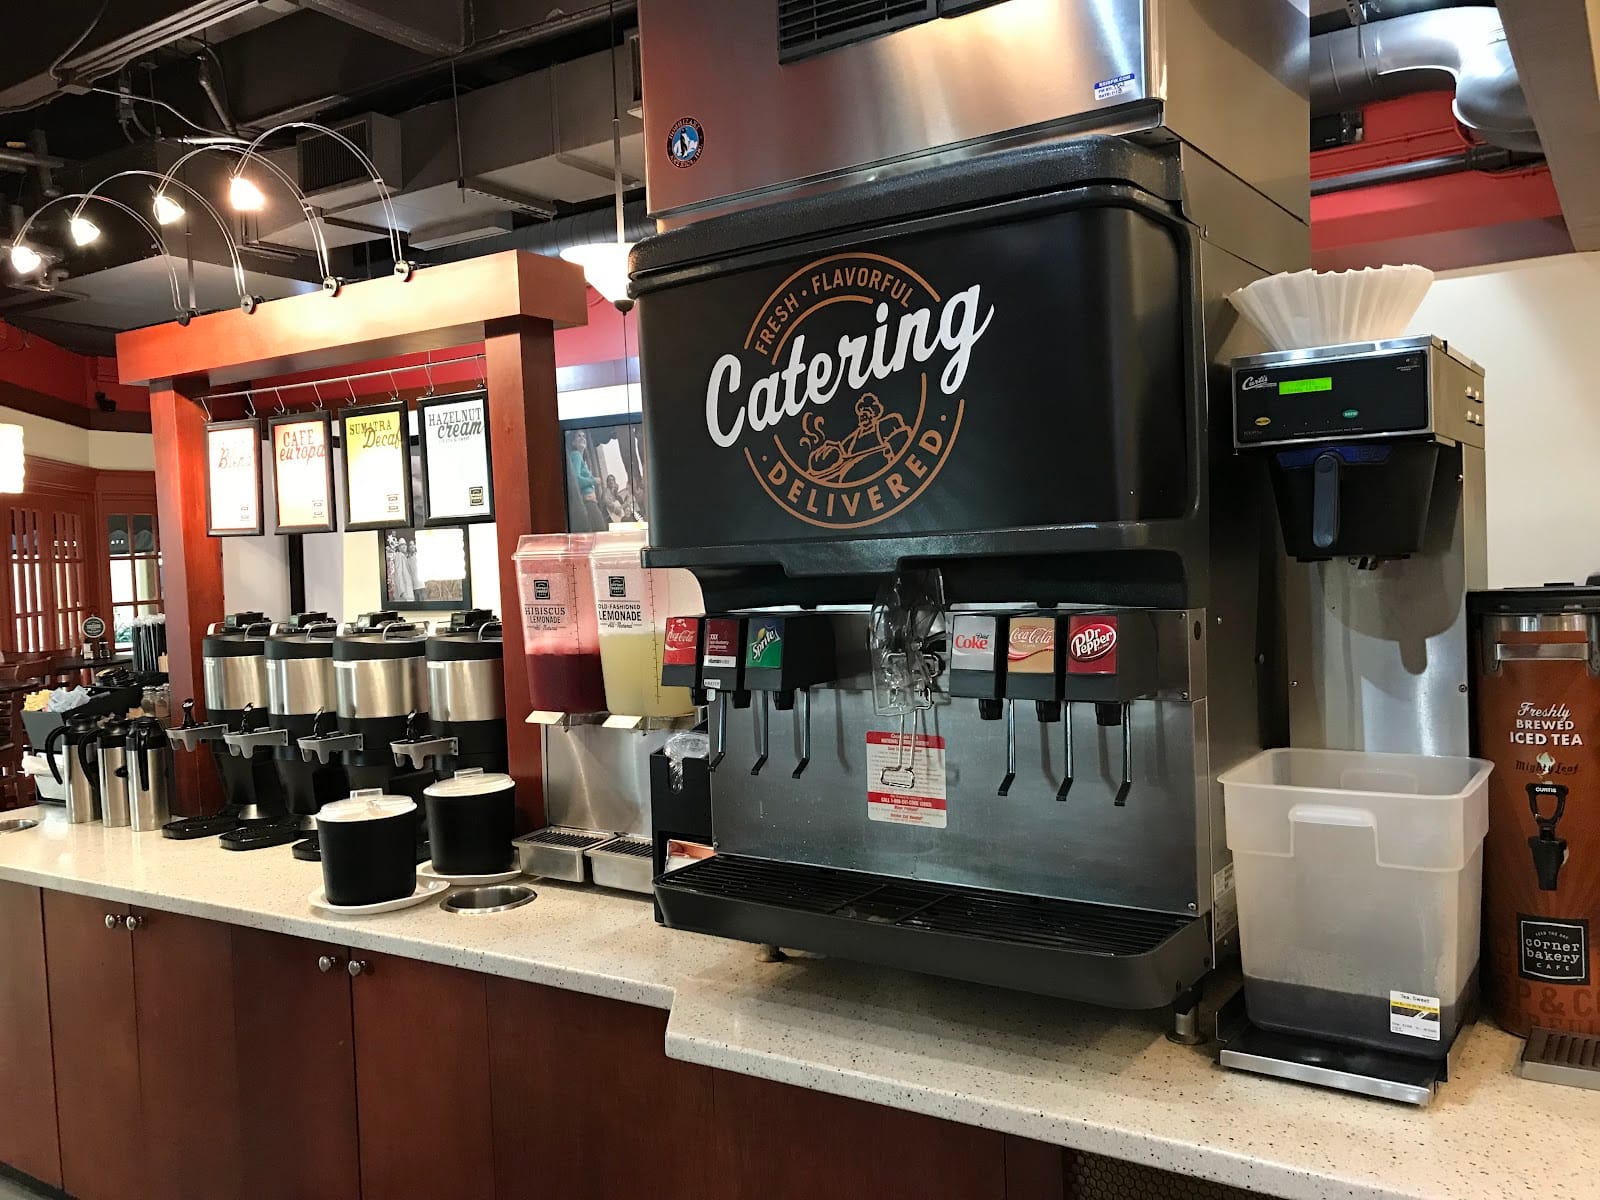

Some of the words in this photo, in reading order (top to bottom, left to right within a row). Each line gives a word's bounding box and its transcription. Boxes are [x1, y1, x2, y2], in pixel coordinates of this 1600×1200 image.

[754, 292, 801, 355] FRESH
[811, 266, 914, 308] FLAVORFUL
[705, 283, 995, 448] Catering
[1242, 375, 1271, 391] Curtis
[428, 407, 482, 426] HAZELNUT
[349, 419, 392, 436] SUMATRA
[437, 420, 483, 439] cream
[282, 428, 314, 448] CAFE
[362, 425, 402, 449] Decaf
[279, 444, 326, 465] europa
[767, 429, 944, 517] DELIVERED
[524, 607, 566, 616] HIBISCUS
[529, 615, 561, 624] LEMONADE
[598, 610, 642, 622] LEMONADE
[955, 634, 988, 649] Coke
[1009, 627, 1053, 645] Coca-Cola
[1084, 628, 1101, 640] Dr
[752, 629, 776, 660] Sprite
[1075, 631, 1114, 657] Pepper
[1517, 702, 1571, 722] Freshly
[1516, 719, 1575, 730] BREWED
[1509, 731, 1548, 745] ICED
[1551, 733, 1583, 746] TEA
[1525, 938, 1580, 952] corner
[1526, 947, 1580, 964] bakery
[1536, 962, 1570, 972] CAFE
